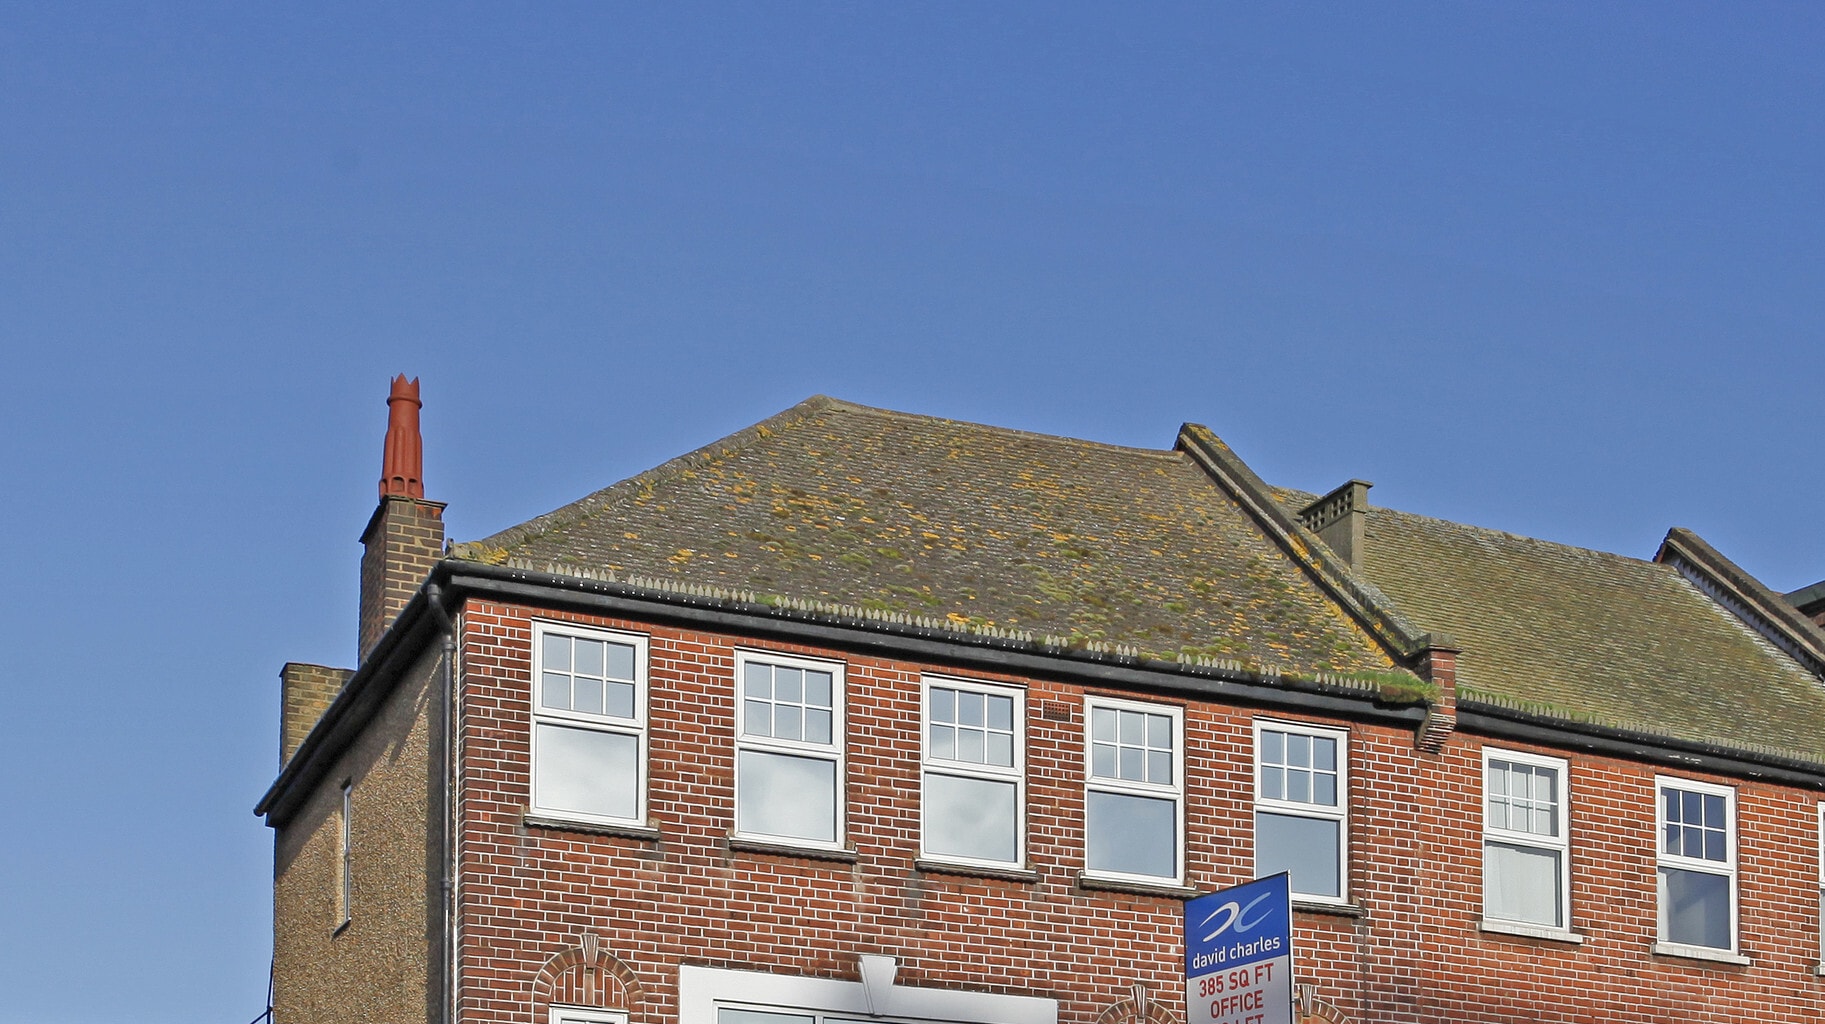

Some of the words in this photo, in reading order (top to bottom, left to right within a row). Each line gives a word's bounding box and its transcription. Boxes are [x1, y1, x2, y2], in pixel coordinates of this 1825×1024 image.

[1193, 946, 1226, 969] david
[1229, 936, 1280, 960] charles
[1199, 975, 1224, 998] 385
[1229, 969, 1250, 990] SQ
[1255, 963, 1274, 984] FT
[1210, 990, 1264, 1018] OFFICE
